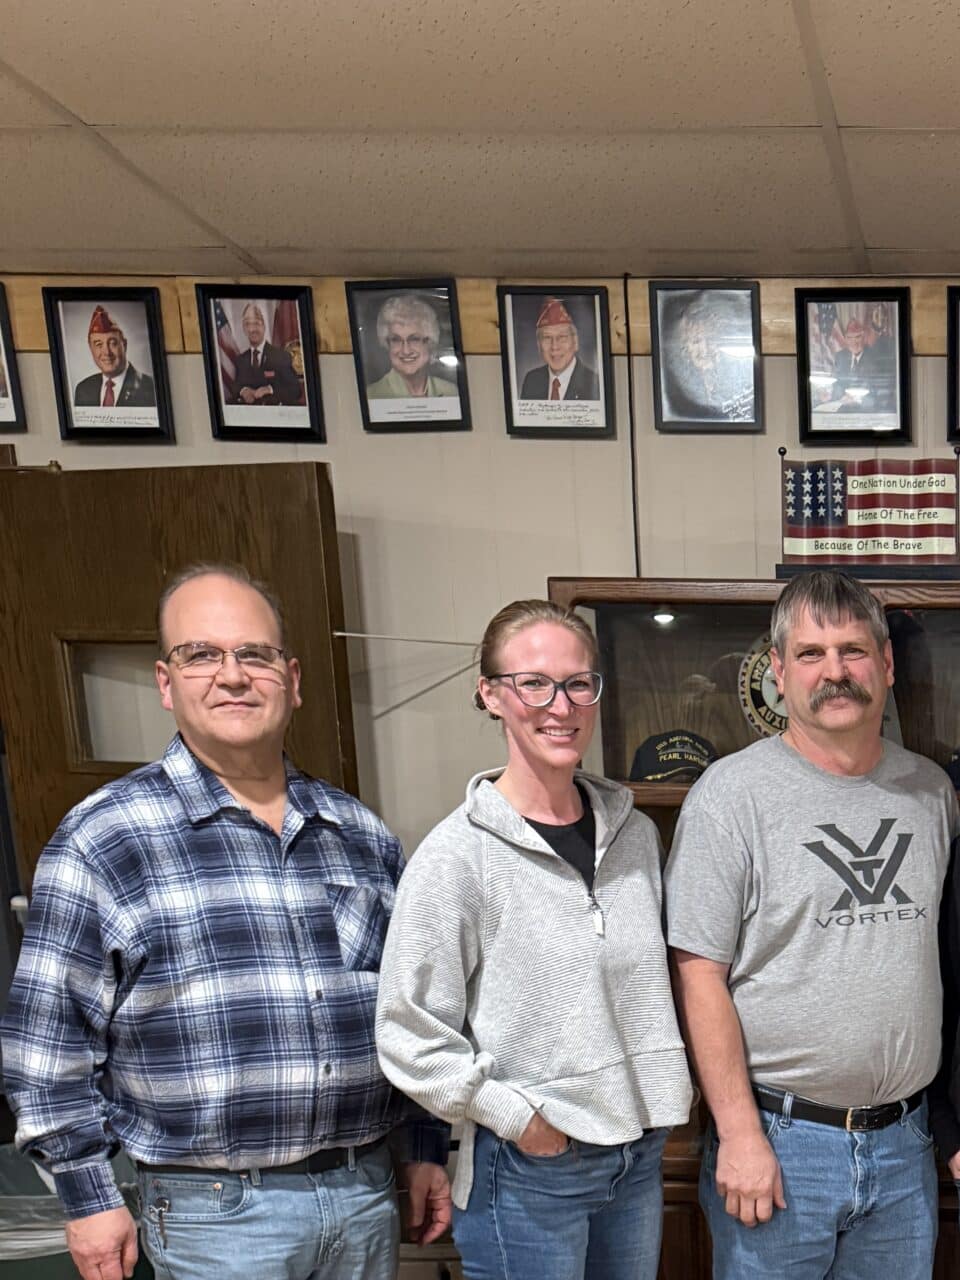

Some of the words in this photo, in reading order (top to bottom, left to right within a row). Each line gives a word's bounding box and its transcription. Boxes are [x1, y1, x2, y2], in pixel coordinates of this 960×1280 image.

[868, 478, 897, 488] Nation
[900, 478, 926, 488] Under
[928, 476, 946, 488] God
[880, 509, 893, 520] Of
[896, 510, 915, 520] The
[917, 510, 939, 520] Free
[814, 540, 853, 551] Because
[856, 540, 869, 550] Of
[871, 540, 889, 550] The
[892, 539, 923, 550] Brave
[659, 752, 682, 762] PEARL
[814, 907, 928, 929] VORTEX
